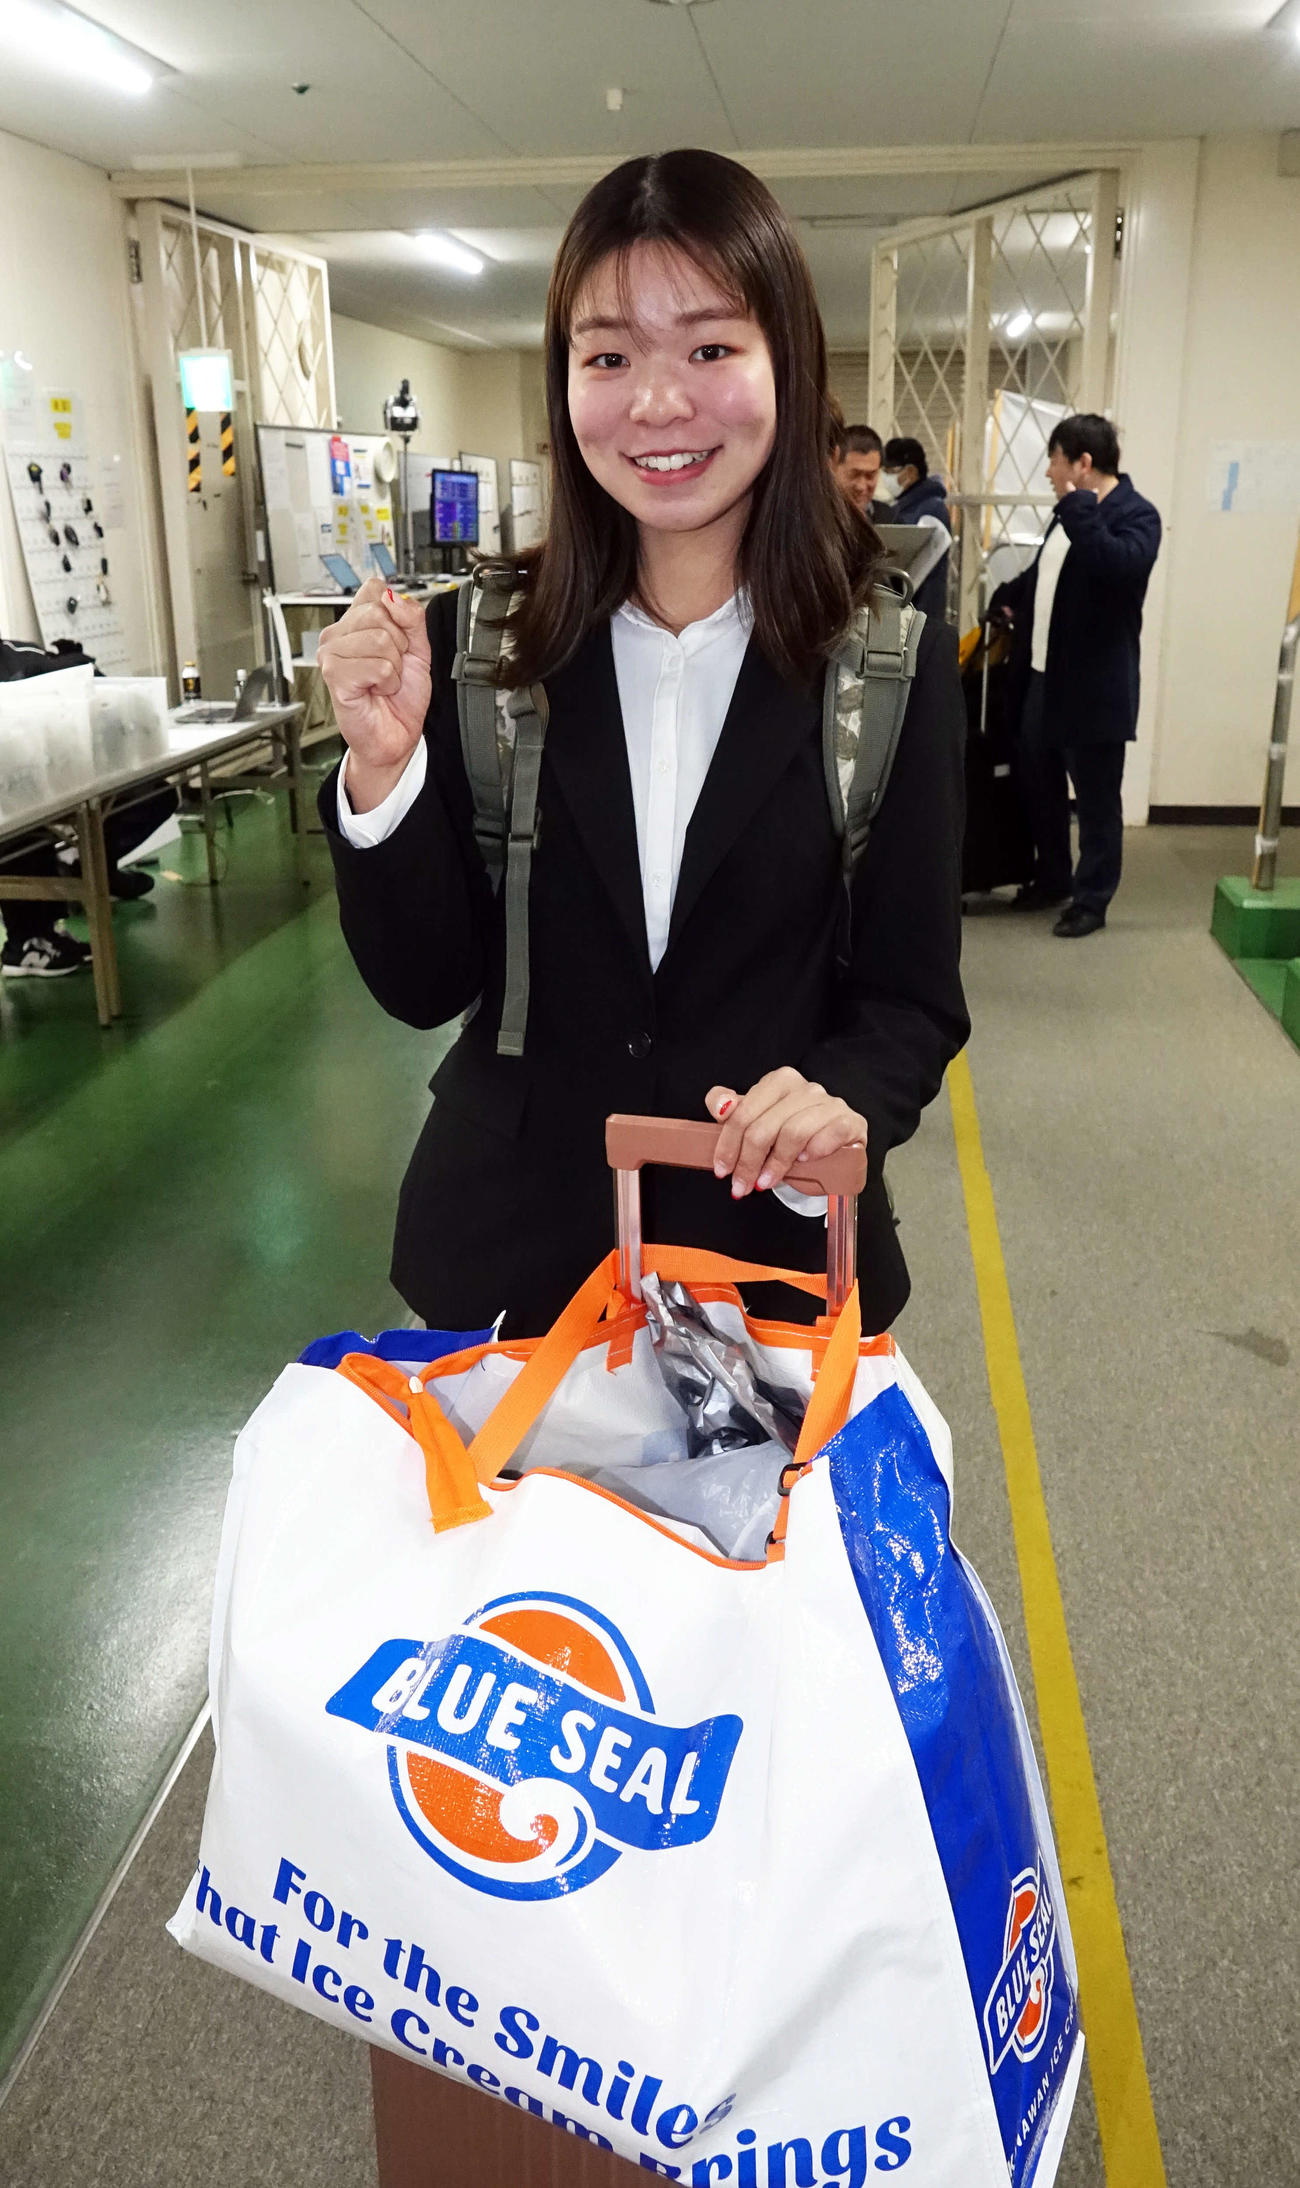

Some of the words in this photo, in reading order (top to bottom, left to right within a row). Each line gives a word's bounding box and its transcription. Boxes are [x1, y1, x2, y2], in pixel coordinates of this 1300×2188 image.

[371, 1657, 540, 1751] BLUE
[550, 1710, 700, 1815] SEAL
[196, 1858, 280, 1963] hat
[291, 1938, 374, 2024] Ice
[273, 1857, 368, 1950] For
[384, 1936, 480, 2029] the
[493, 2005, 736, 2150] Smiles
[996, 1945, 1029, 2038] BLUE
[1029, 1883, 1052, 1962] SEAL
[1051, 2033, 1063, 2073] ICE
